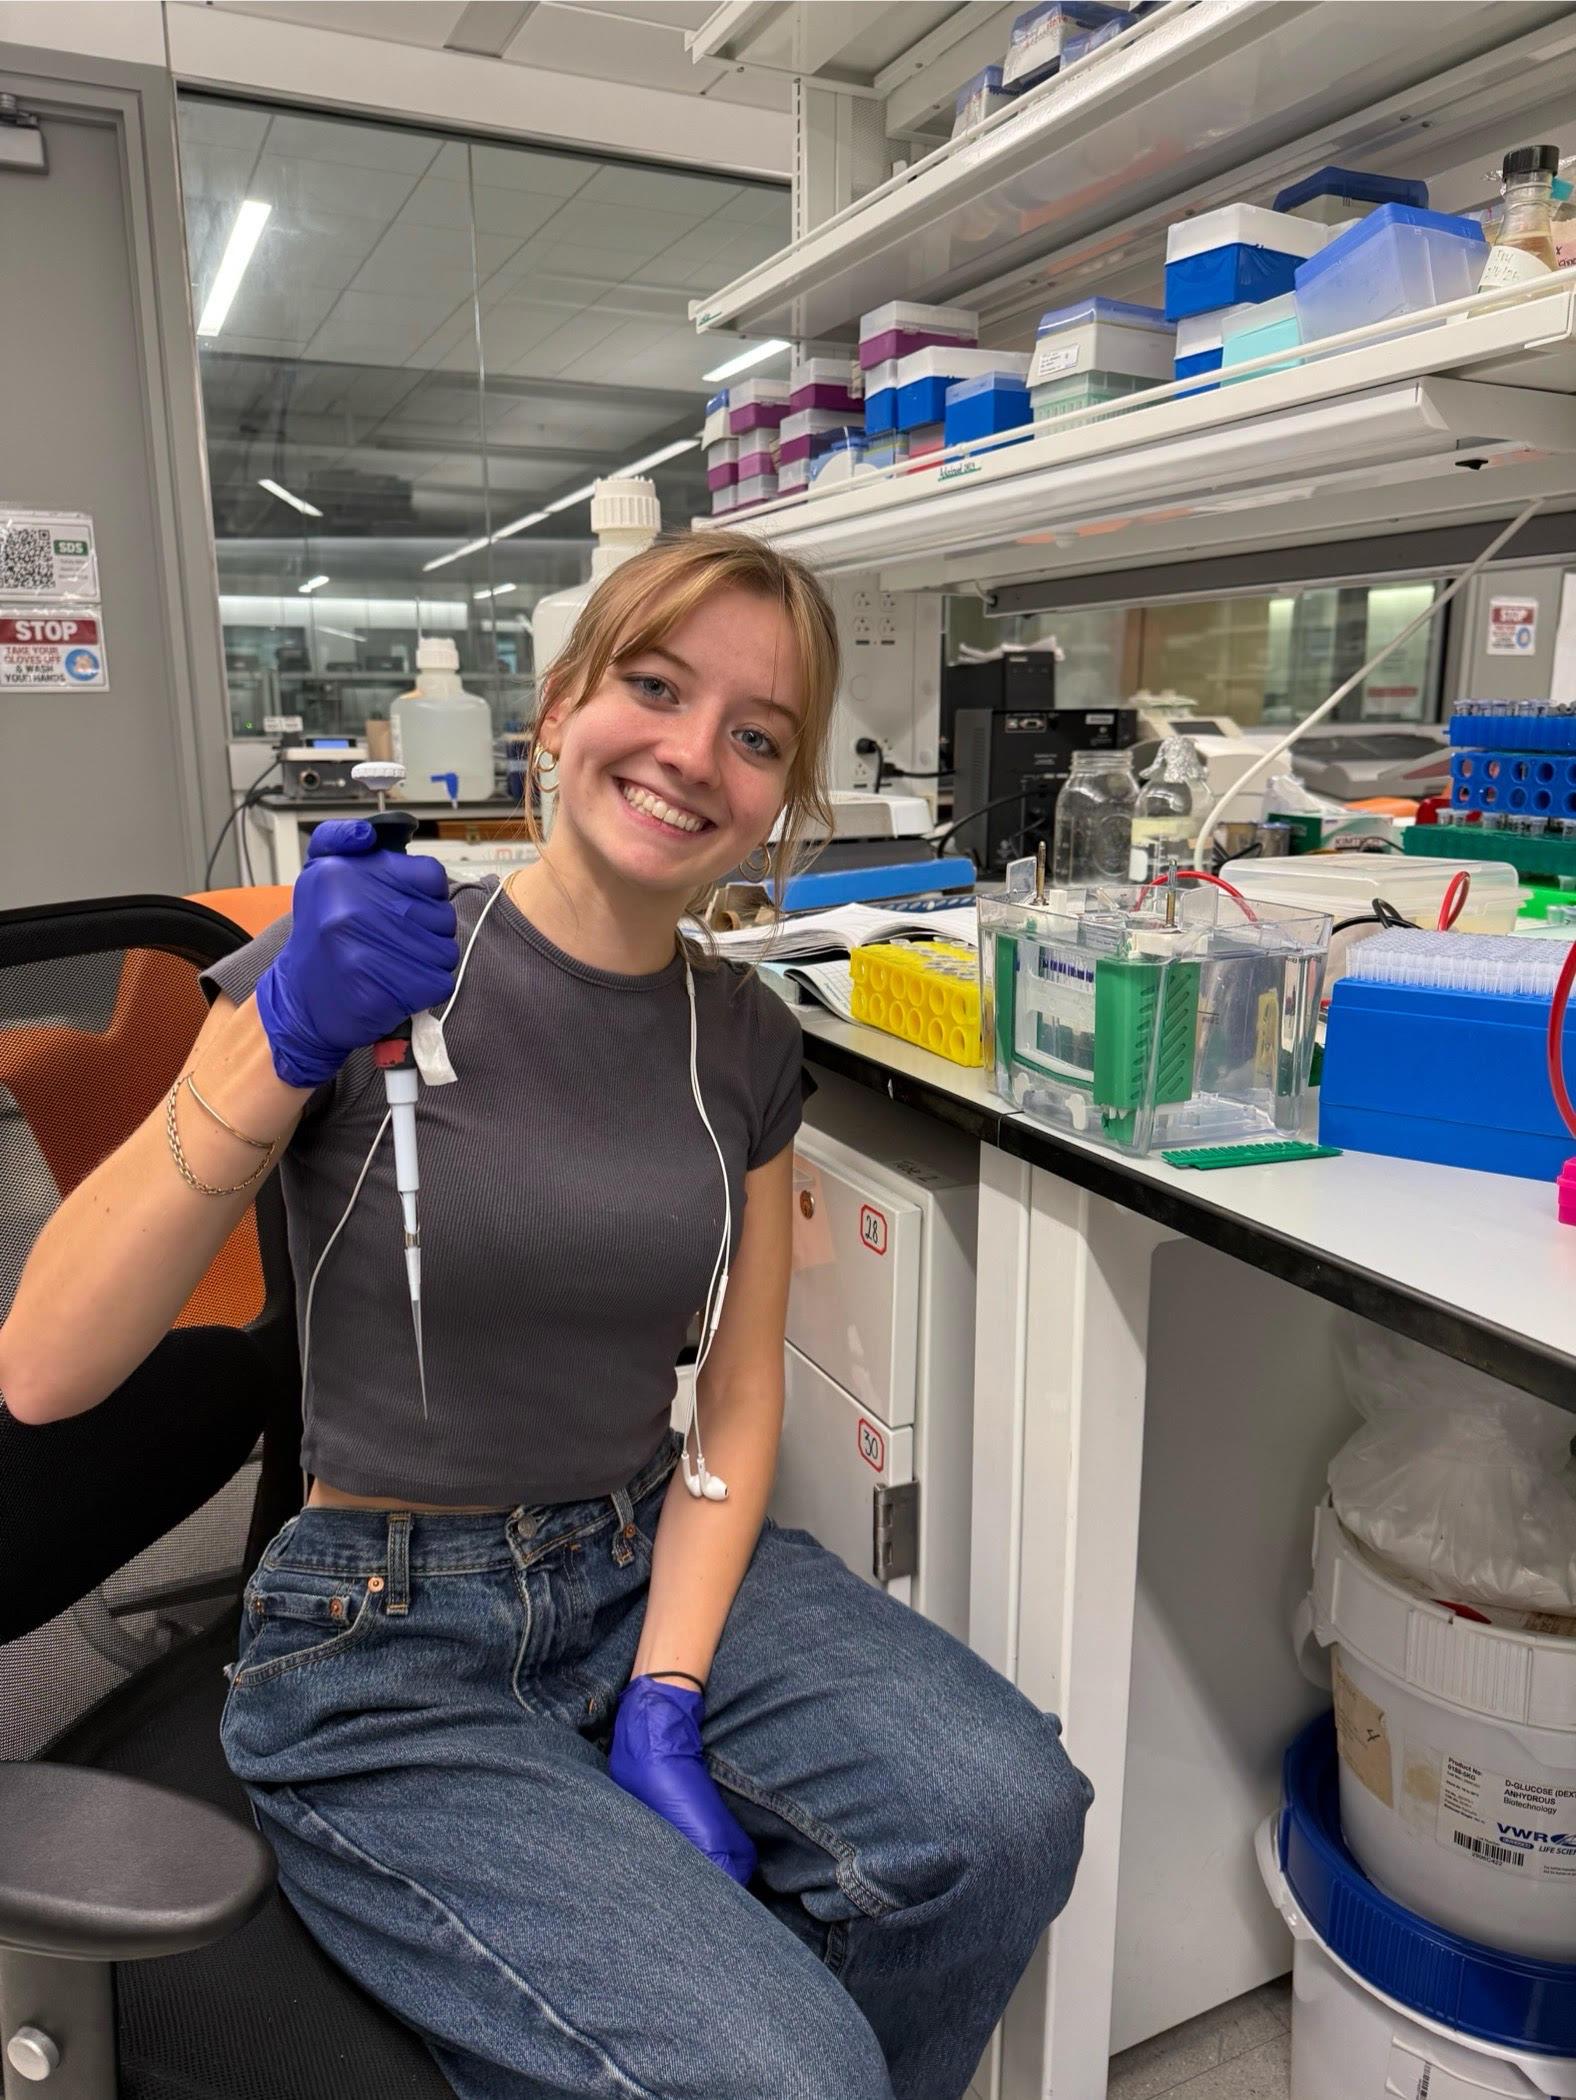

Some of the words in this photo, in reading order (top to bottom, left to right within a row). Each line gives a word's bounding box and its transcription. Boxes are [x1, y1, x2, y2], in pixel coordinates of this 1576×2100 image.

[59, 541, 84, 554] SDS
[15, 620, 78, 641] STOP
[25, 665, 54, 673] WASH
[864, 1214, 879, 1245] 28
[863, 1429, 879, 1460] 30
[1448, 1757, 1472, 1771] Product
[1505, 1779, 1553, 1796] D-GLUCOSE
[1504, 1789, 1556, 1805] ANHYDROUS
[1503, 1797, 1557, 1815] Biotechnology
[1497, 1822, 1548, 1843] VWR
[1538, 1845, 1555, 1855] LIFE
